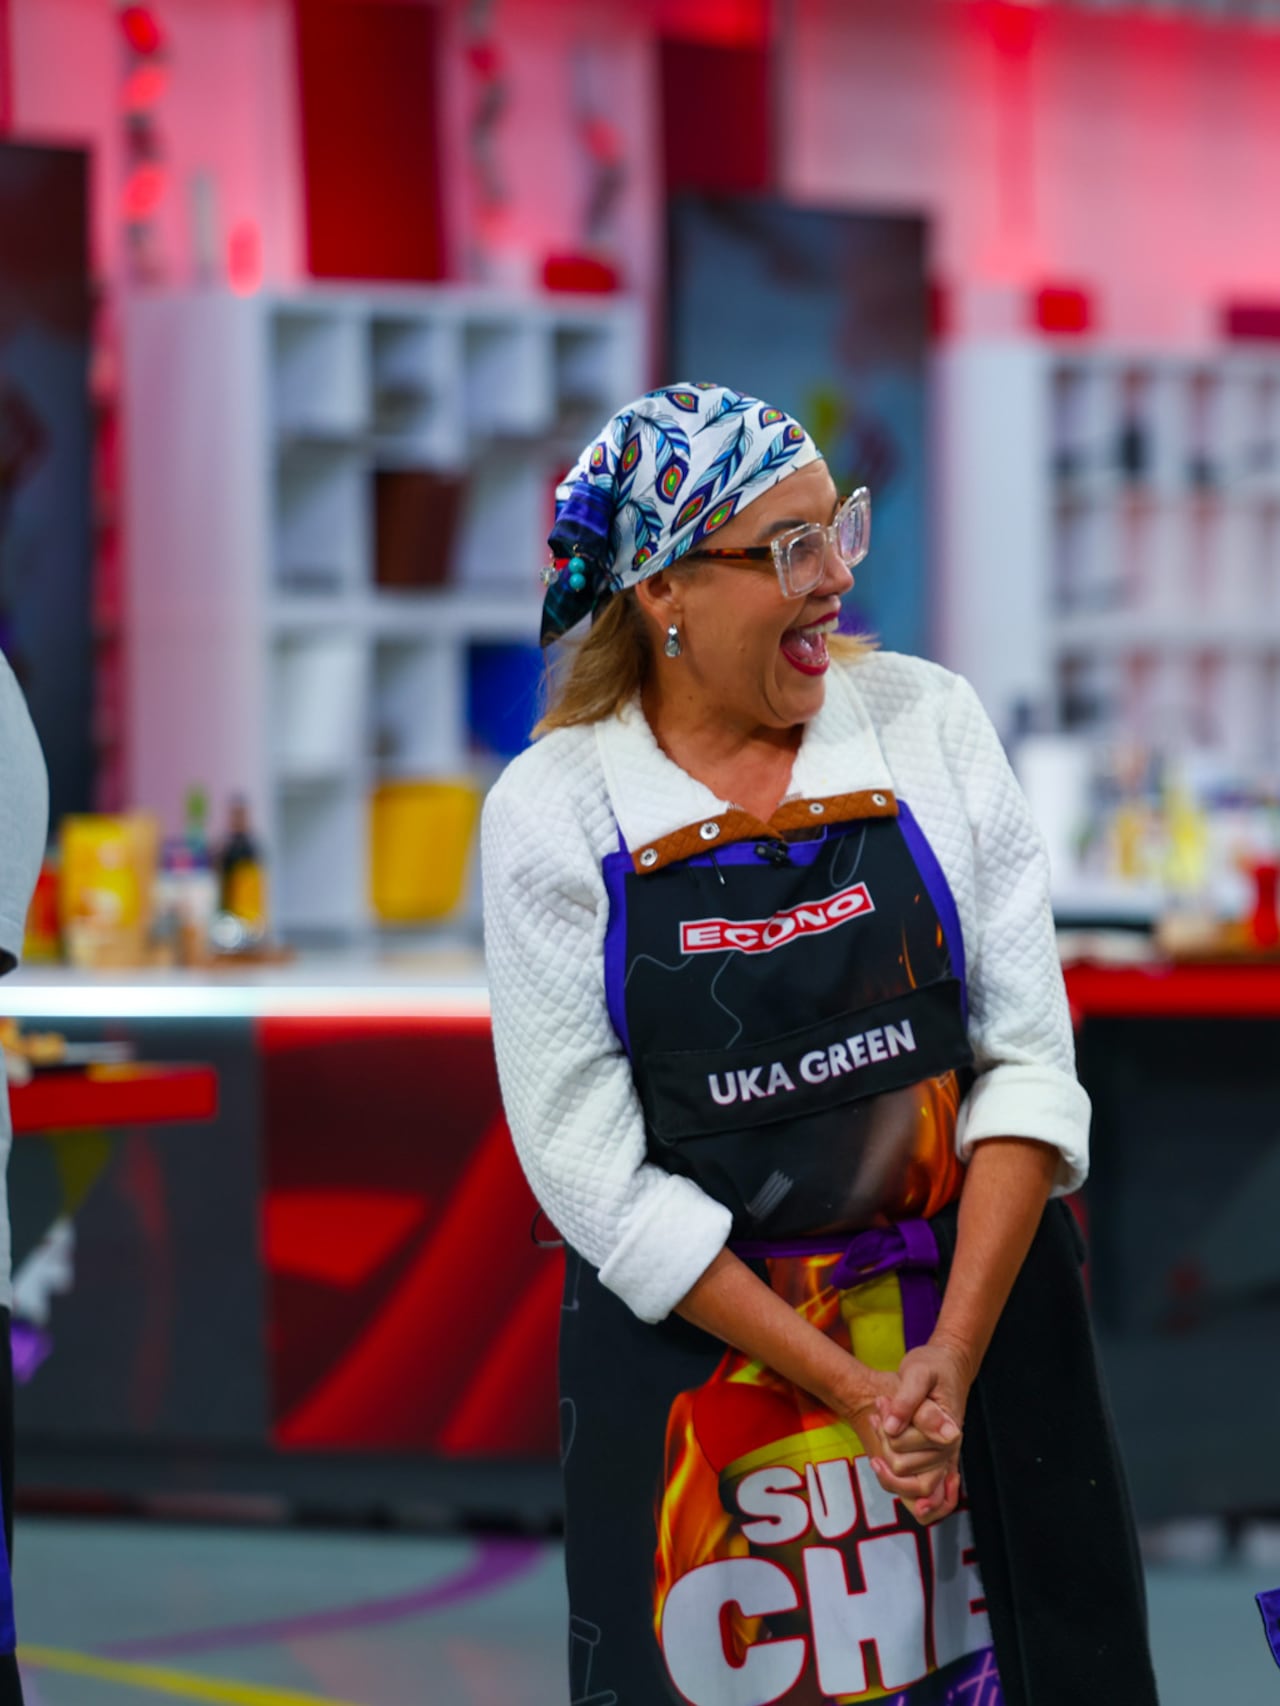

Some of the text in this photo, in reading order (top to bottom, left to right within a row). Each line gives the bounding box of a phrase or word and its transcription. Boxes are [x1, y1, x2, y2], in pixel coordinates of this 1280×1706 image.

[684, 891, 867, 948] ECONO
[707, 1019, 917, 1106] UKA GREEN
[660, 1508, 995, 1706] CHE
